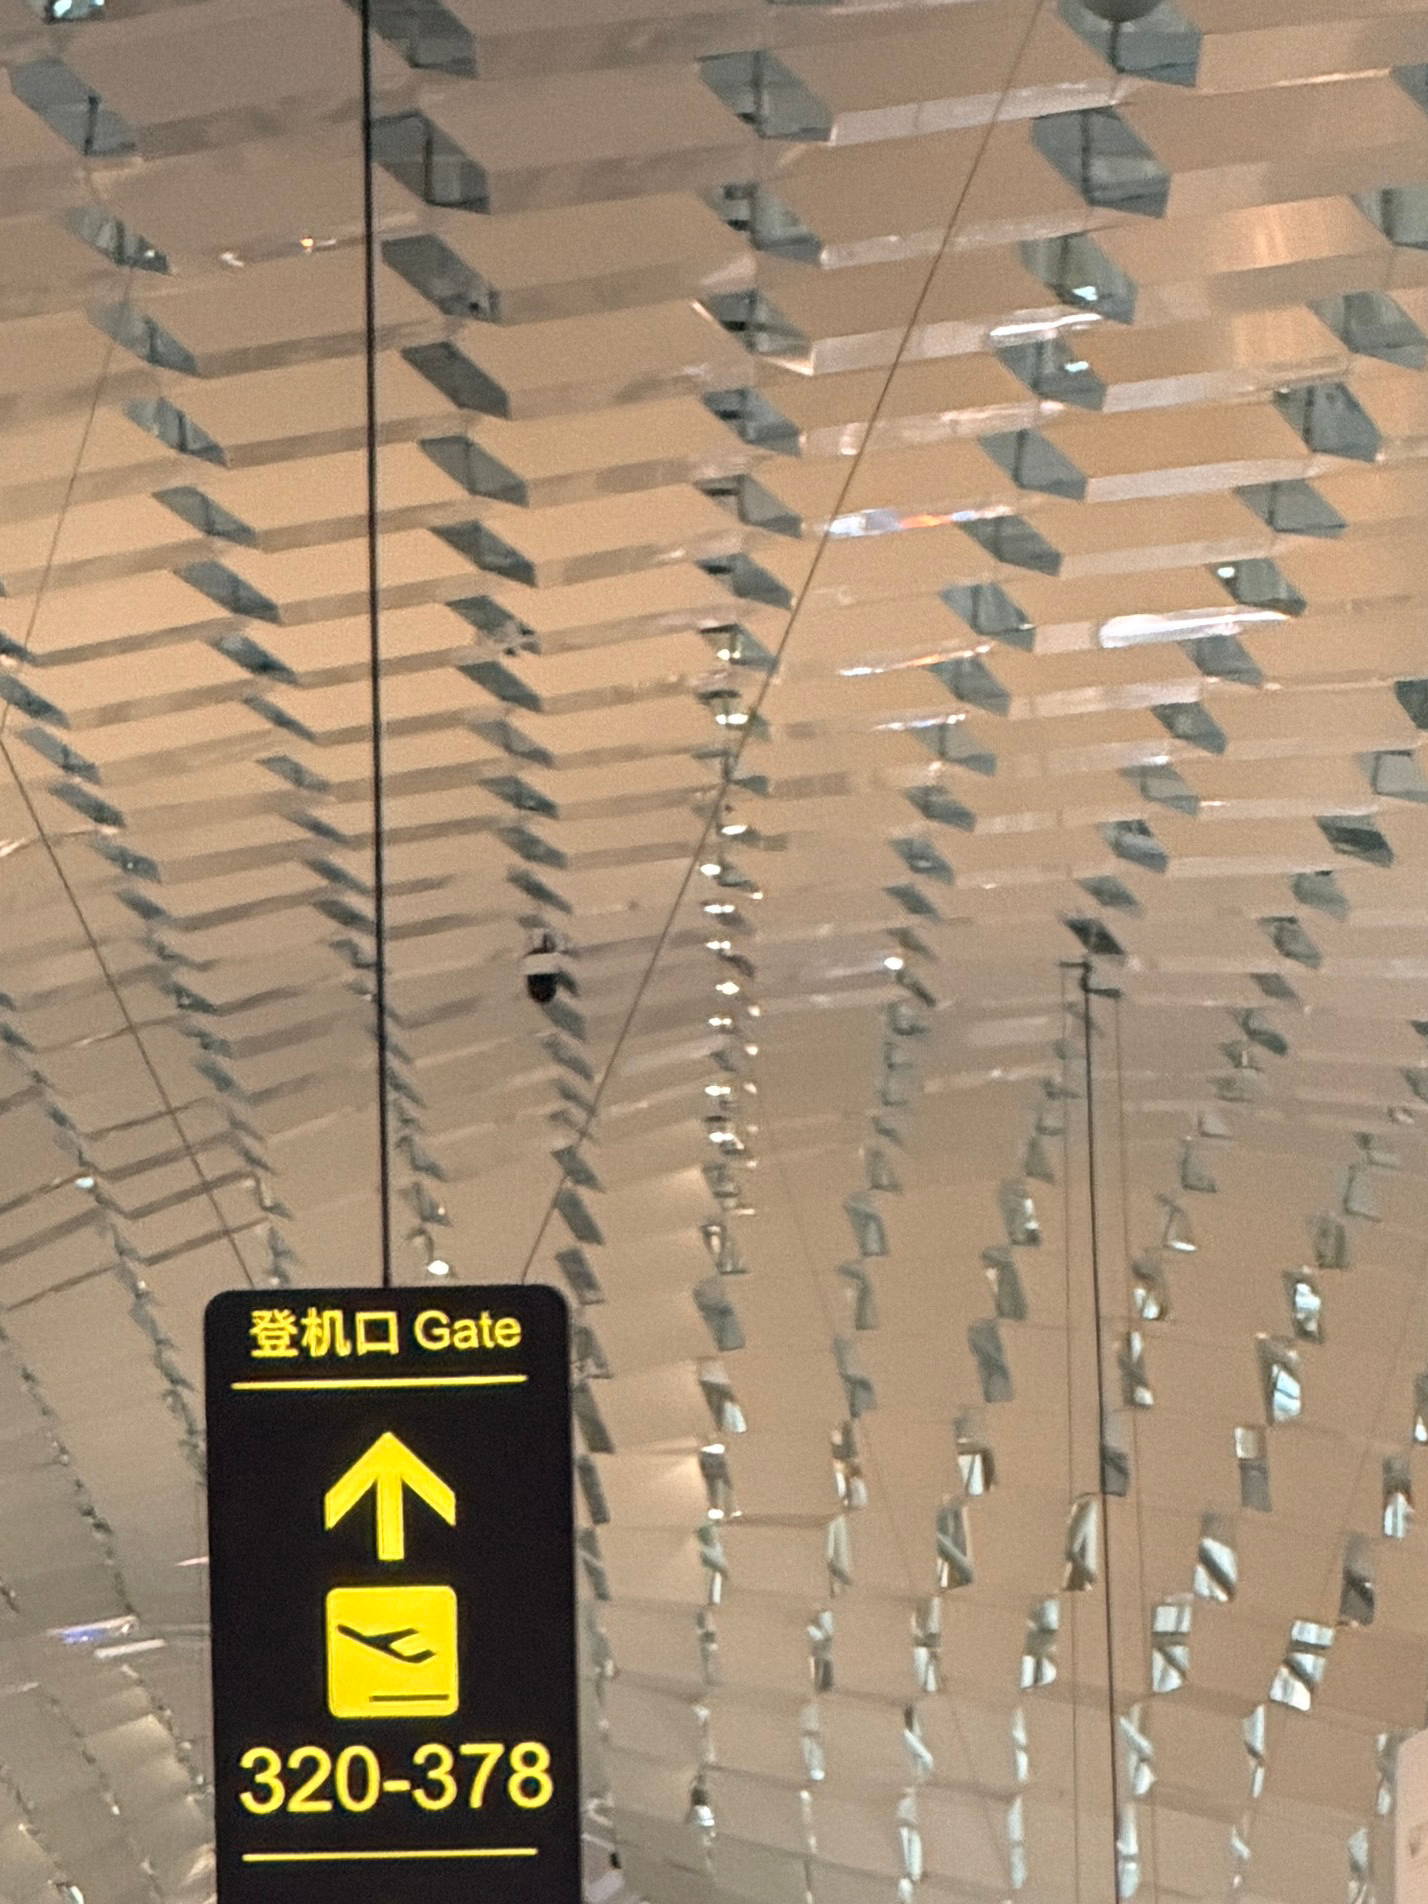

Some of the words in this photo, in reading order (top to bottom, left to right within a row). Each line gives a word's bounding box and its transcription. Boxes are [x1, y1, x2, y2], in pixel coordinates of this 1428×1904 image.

[249, 1307, 399, 1358] 登机口
[414, 1310, 522, 1350] Gate
[240, 1742, 554, 1814] 320-378
